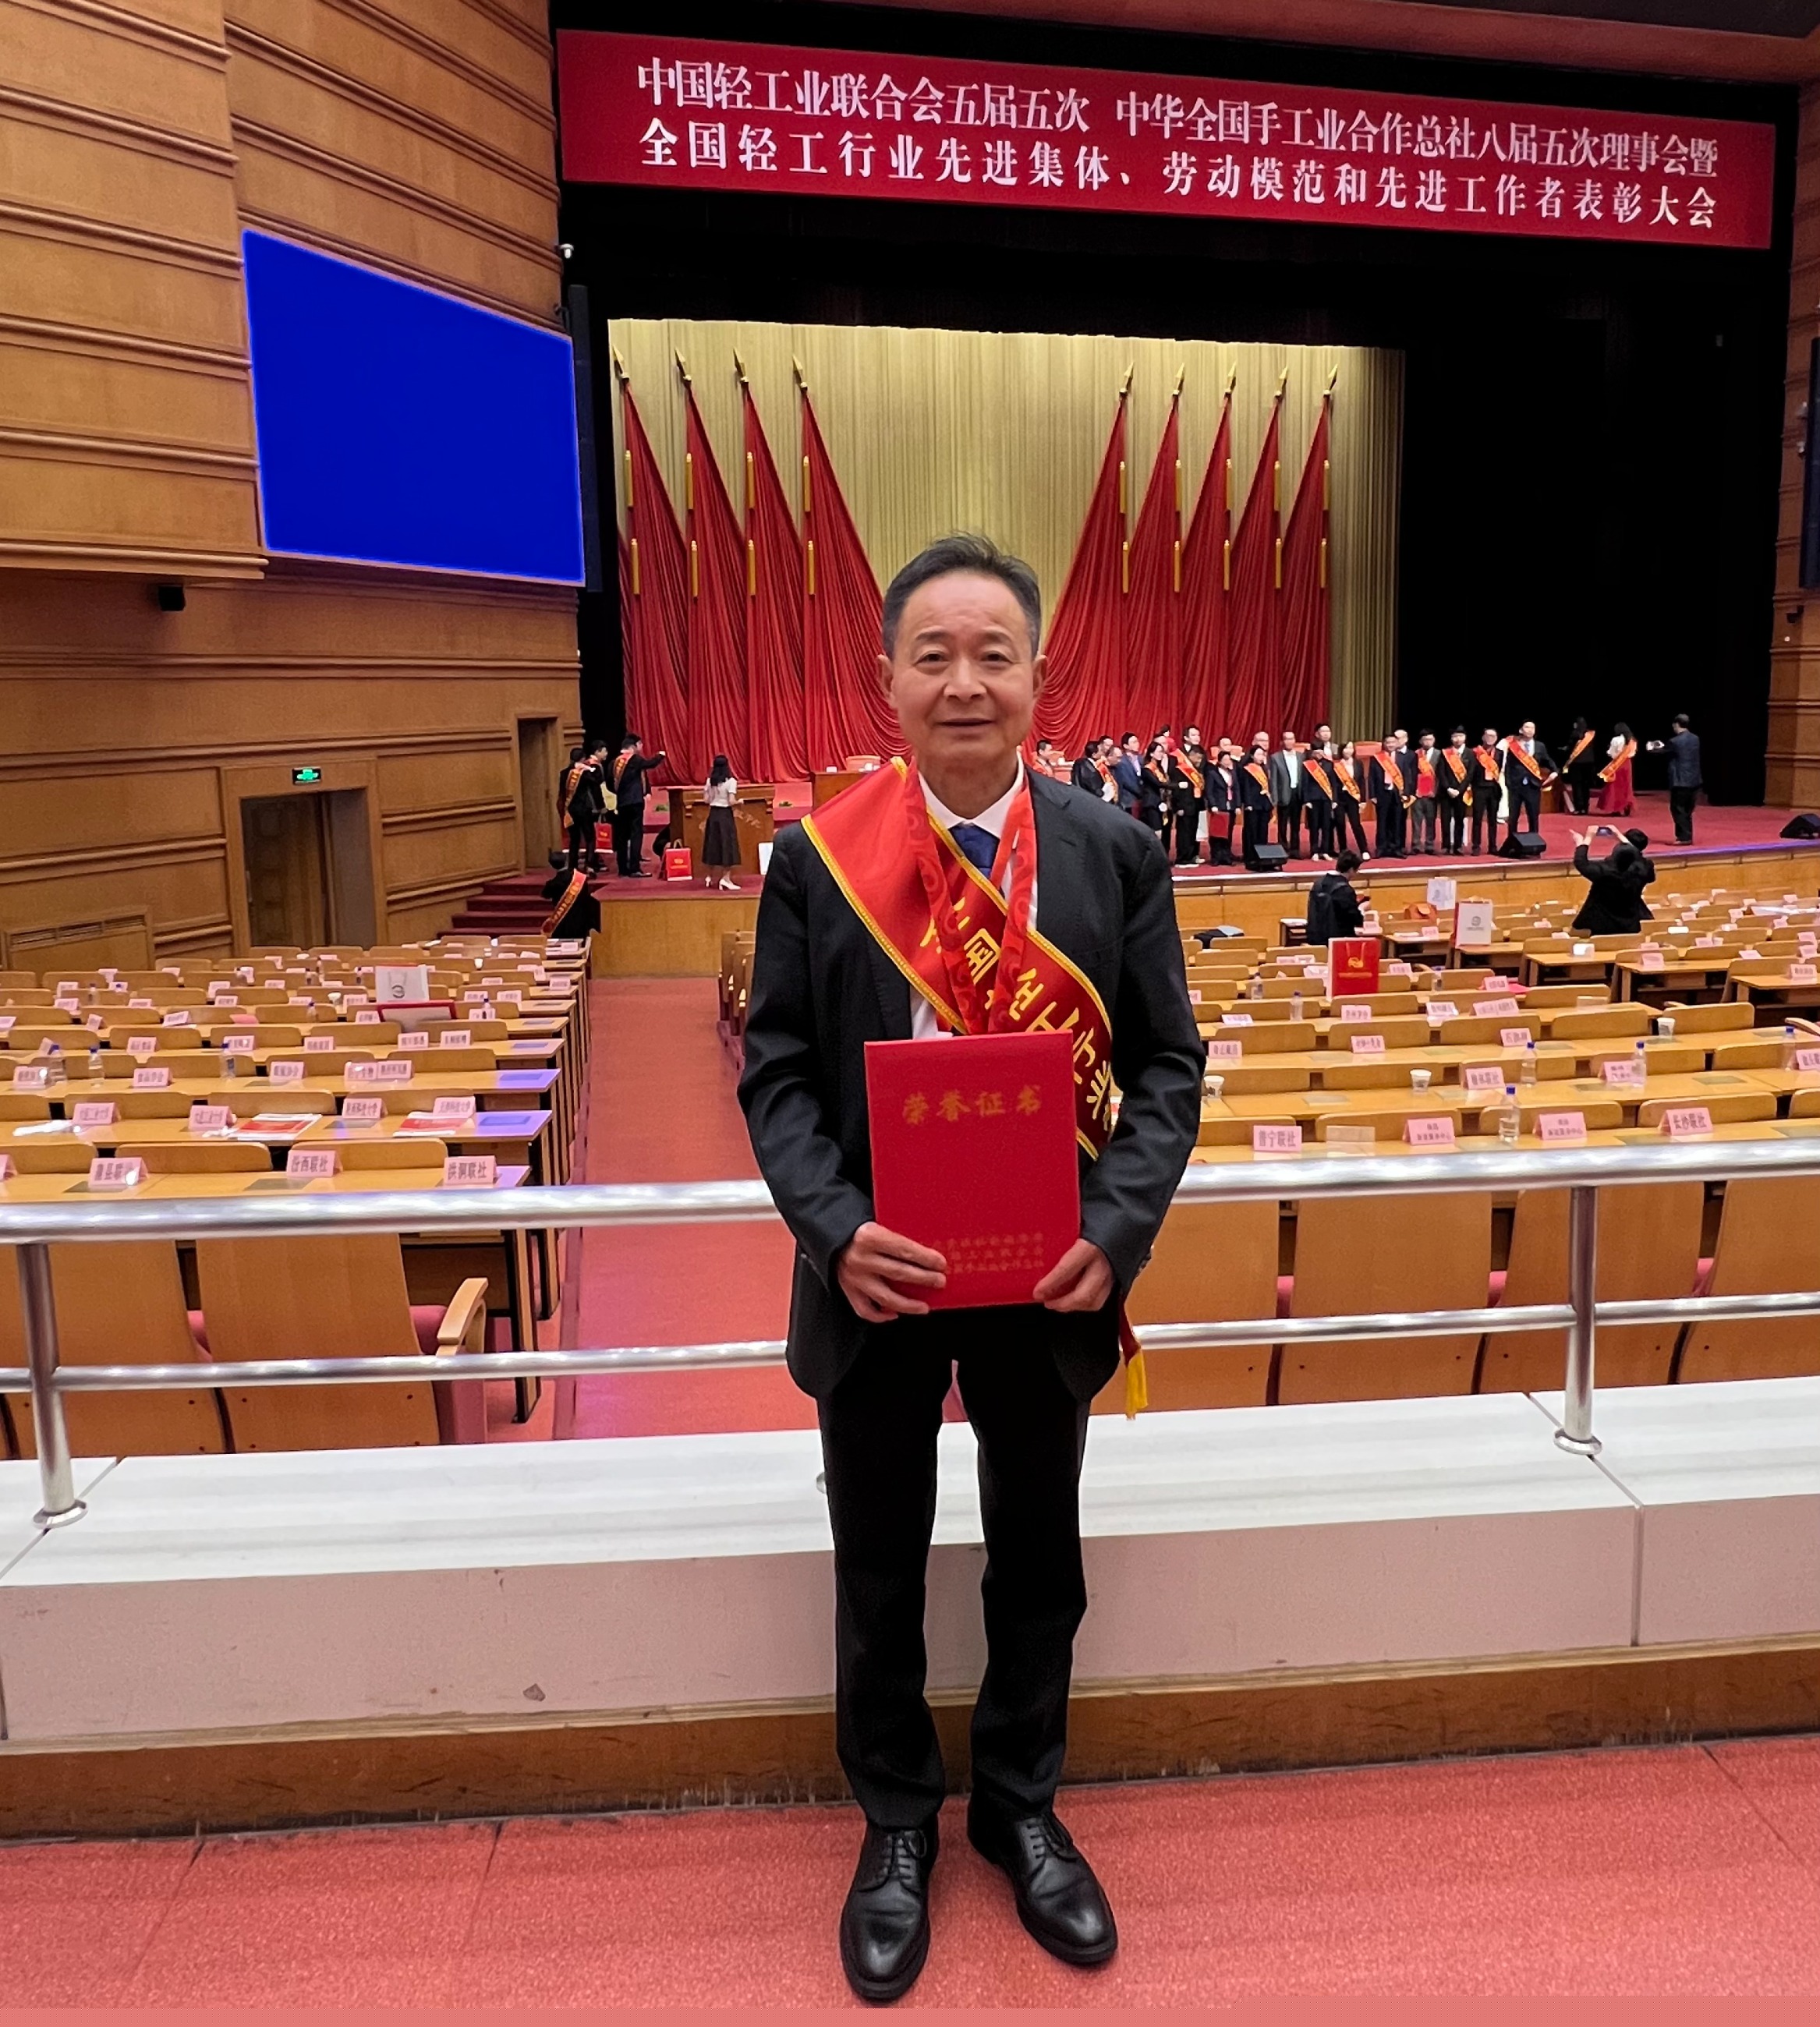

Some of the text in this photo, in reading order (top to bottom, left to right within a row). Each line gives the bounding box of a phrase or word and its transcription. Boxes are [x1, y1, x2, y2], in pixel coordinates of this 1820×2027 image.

[638, 57, 1718, 178] 中国轻工业联合会五届五次 中华全国手工业合作总社八届五次理事会暨
[639, 117, 1717, 229] 全国轻工行业先进集体、劳动模范和先进工作者表彰大会
